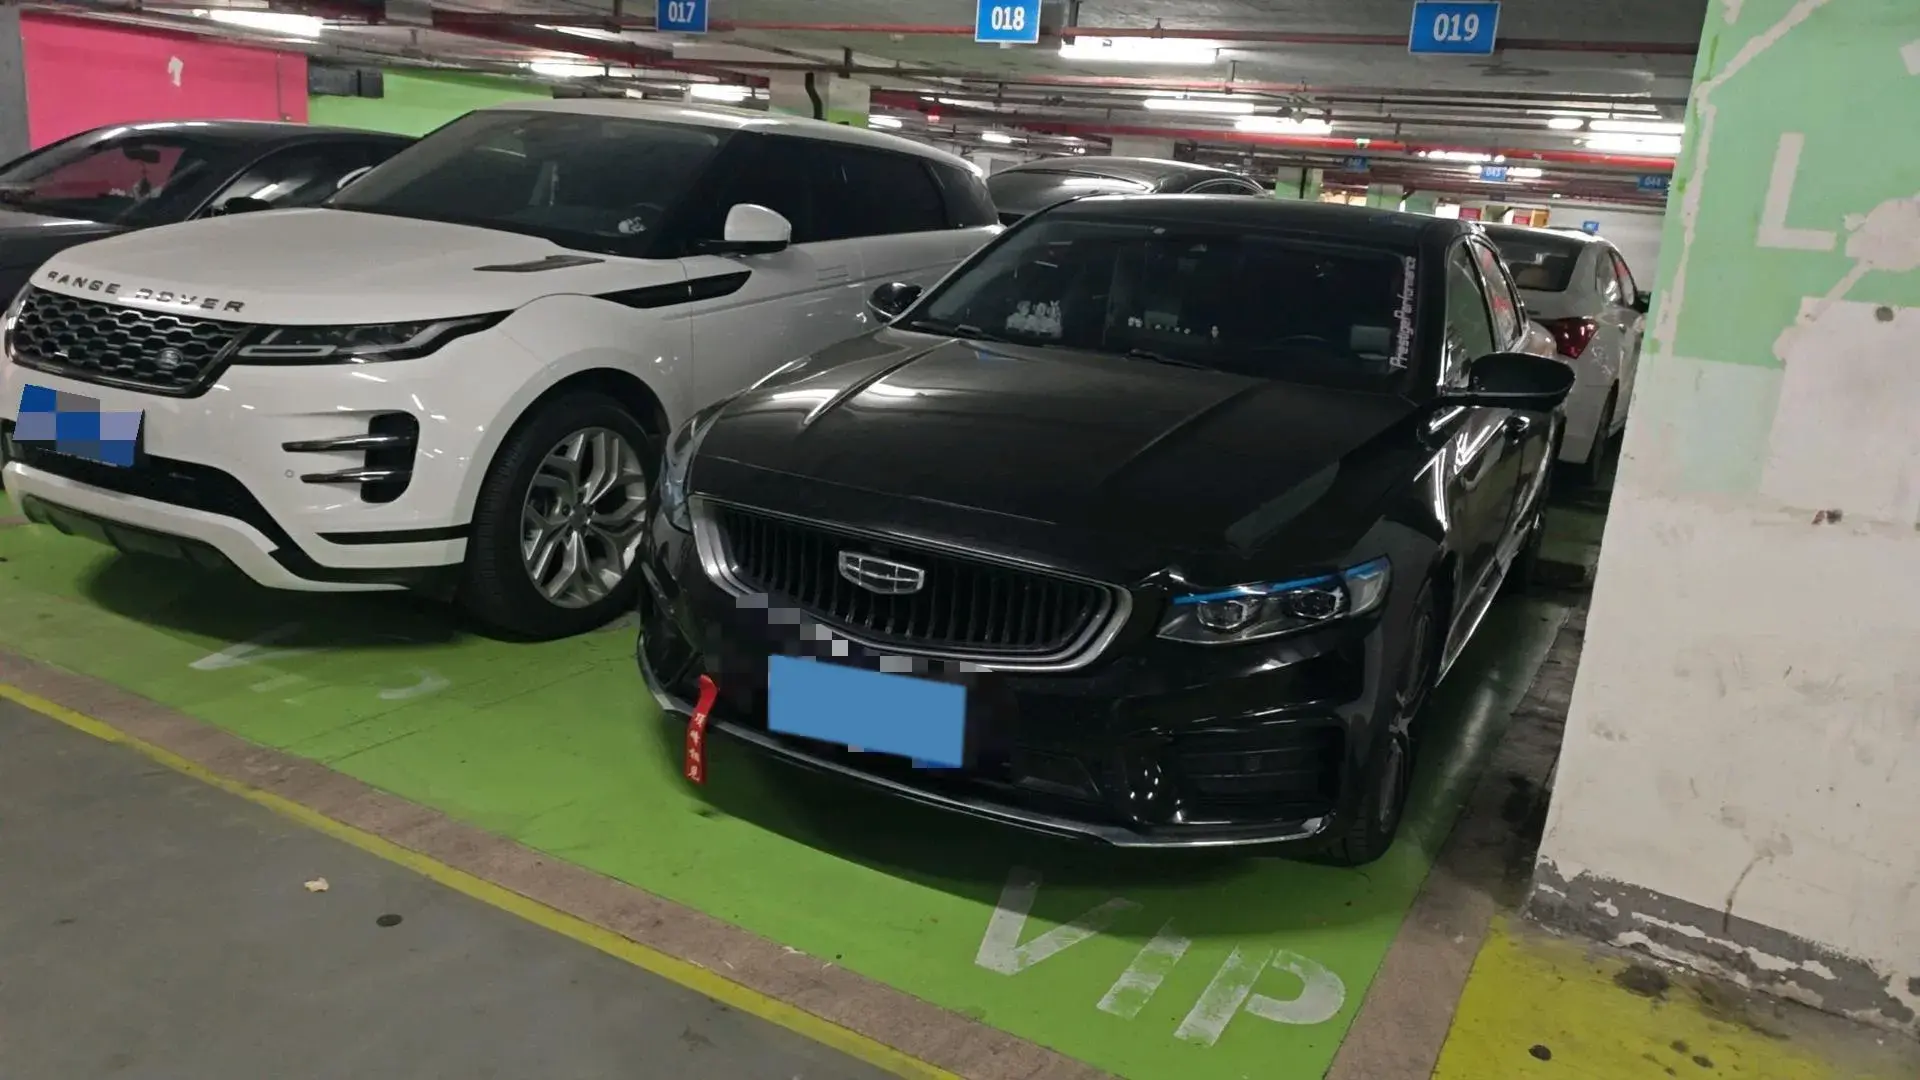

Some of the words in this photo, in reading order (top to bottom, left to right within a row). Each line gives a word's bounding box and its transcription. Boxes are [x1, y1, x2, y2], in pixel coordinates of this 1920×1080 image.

[668, 1, 695, 23] 017
[991, 6, 1026, 31] 018
[1433, 13, 1480, 42] 019
[47, 270, 122, 295] RANGE
[136, 287, 245, 313] ROVER
[974, 866, 1346, 1047] VIP
